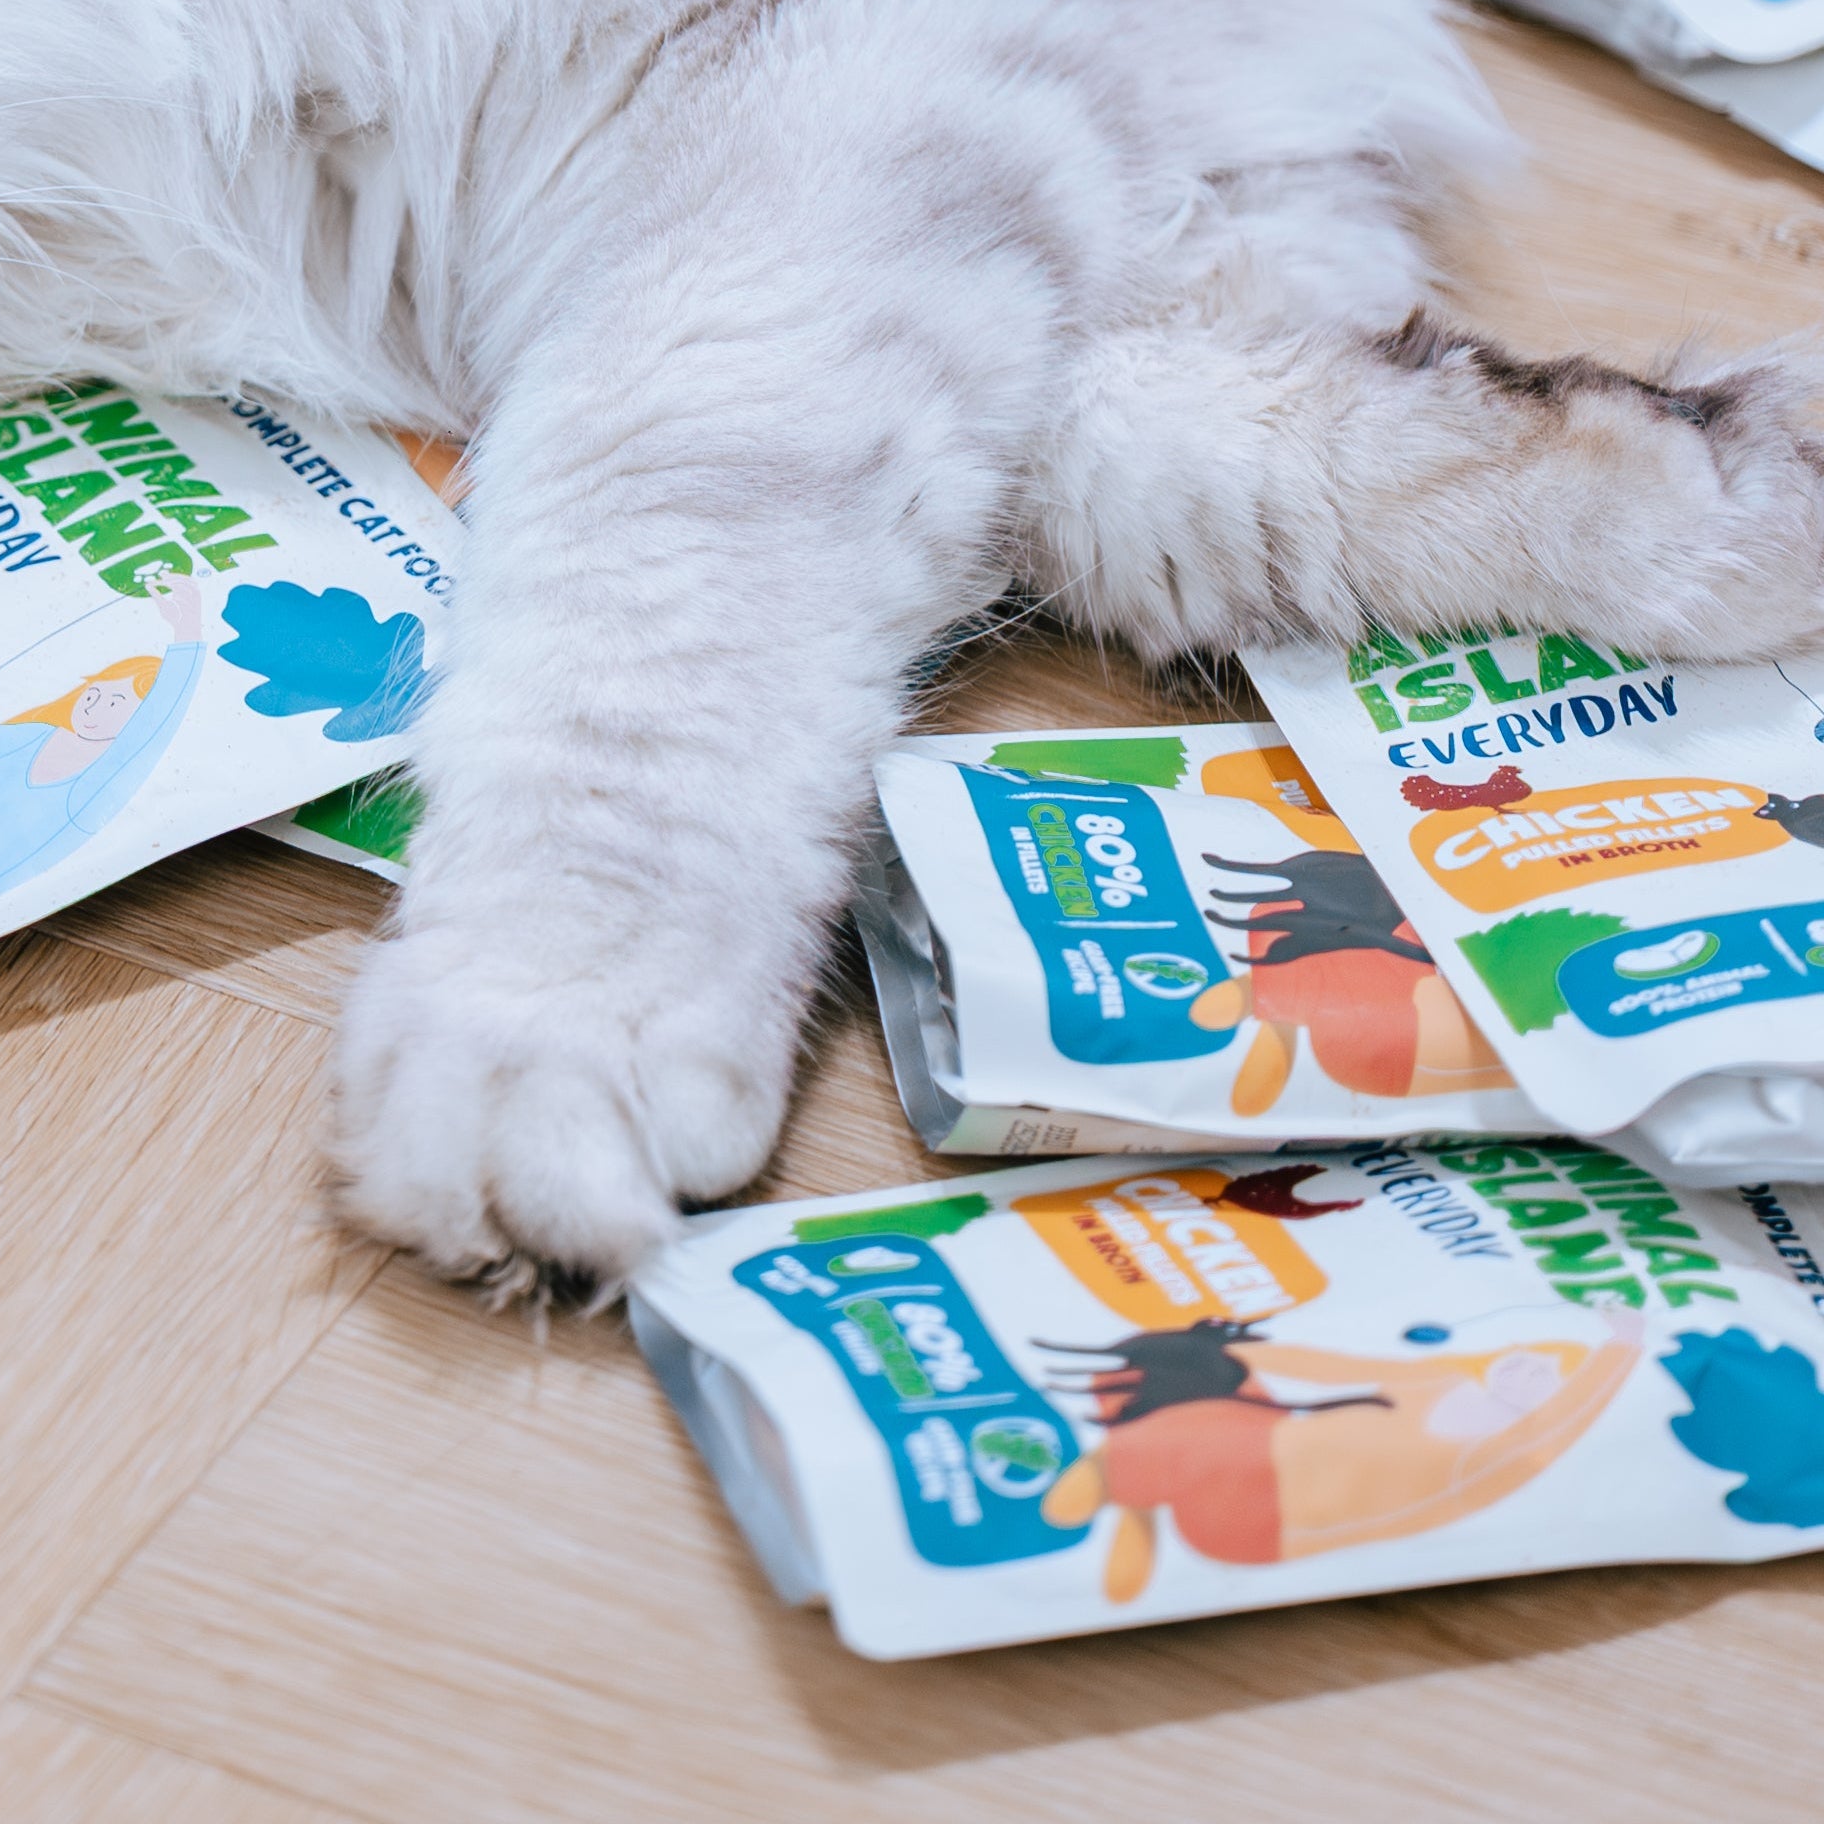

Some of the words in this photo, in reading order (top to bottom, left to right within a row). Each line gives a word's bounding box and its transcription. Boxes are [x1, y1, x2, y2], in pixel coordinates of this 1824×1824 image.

[222, 395, 353, 497] OMPLETE
[339, 497, 405, 543] CAT
[385, 542, 456, 597] FOO
[1353, 628, 1653, 734] ISLA
[1388, 675, 1679, 769] EVERYDAY
[1015, 841, 1049, 894] FILLETS
[1028, 803, 1099, 917] CHICKEN
[1075, 813, 1149, 908] 80%
[1434, 788, 1755, 870] CHICKEN
[1500, 832, 1613, 870] PULLED
[1614, 816, 1731, 845] FILLETS
[1557, 852, 1593, 868] IN
[1602, 838, 1702, 860] BROTH
[1113, 1177, 1297, 1319] CHICKEN
[1350, 1148, 1514, 1260] EVERYDAY
[1434, 1144, 1647, 1310] SLAND
[1548, 1144, 1739, 1308] NIMAL
